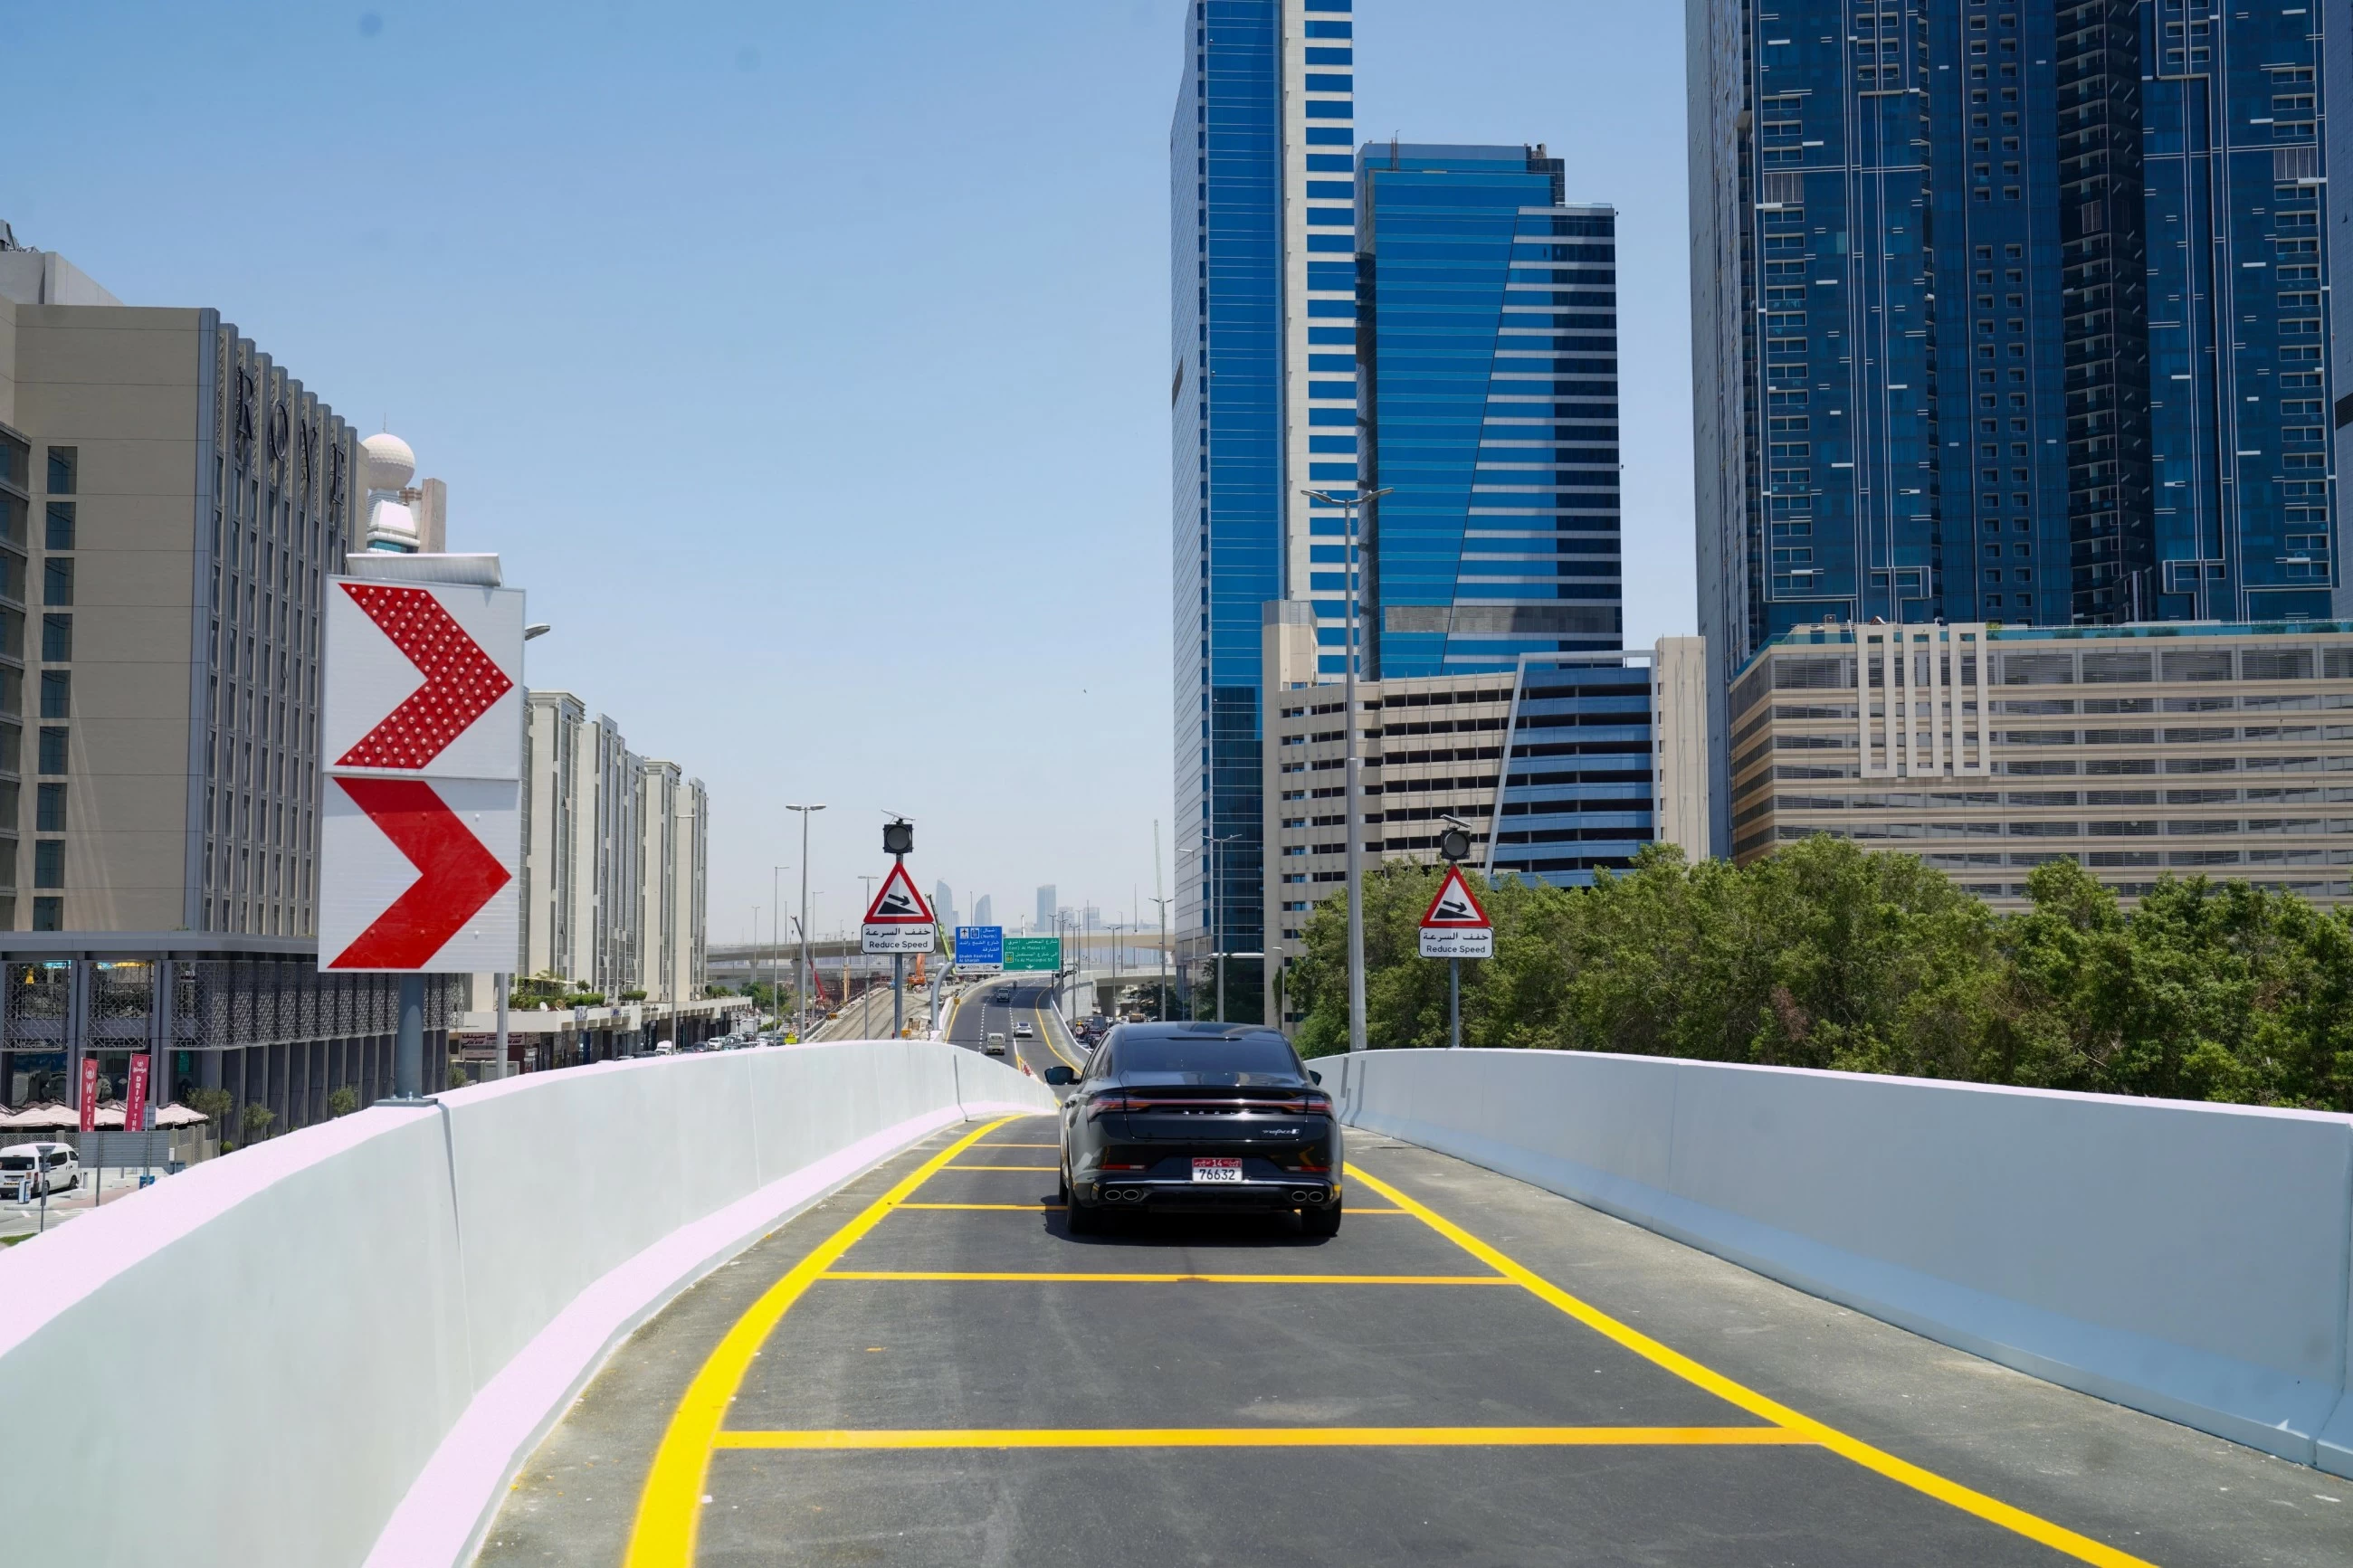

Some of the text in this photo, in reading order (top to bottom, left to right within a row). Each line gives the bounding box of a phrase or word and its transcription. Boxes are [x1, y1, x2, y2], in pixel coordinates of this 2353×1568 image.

[238, 366, 345, 507] ROVE
[865, 927, 900, 937] السرعة
[1424, 932, 1458, 942] السرعة
[902, 941, 928, 949] Speed
[1426, 945, 1485, 954] Reduce Speed
[1212, 1159, 1223, 1167] 14
[1199, 1168, 1235, 1181] 76632
